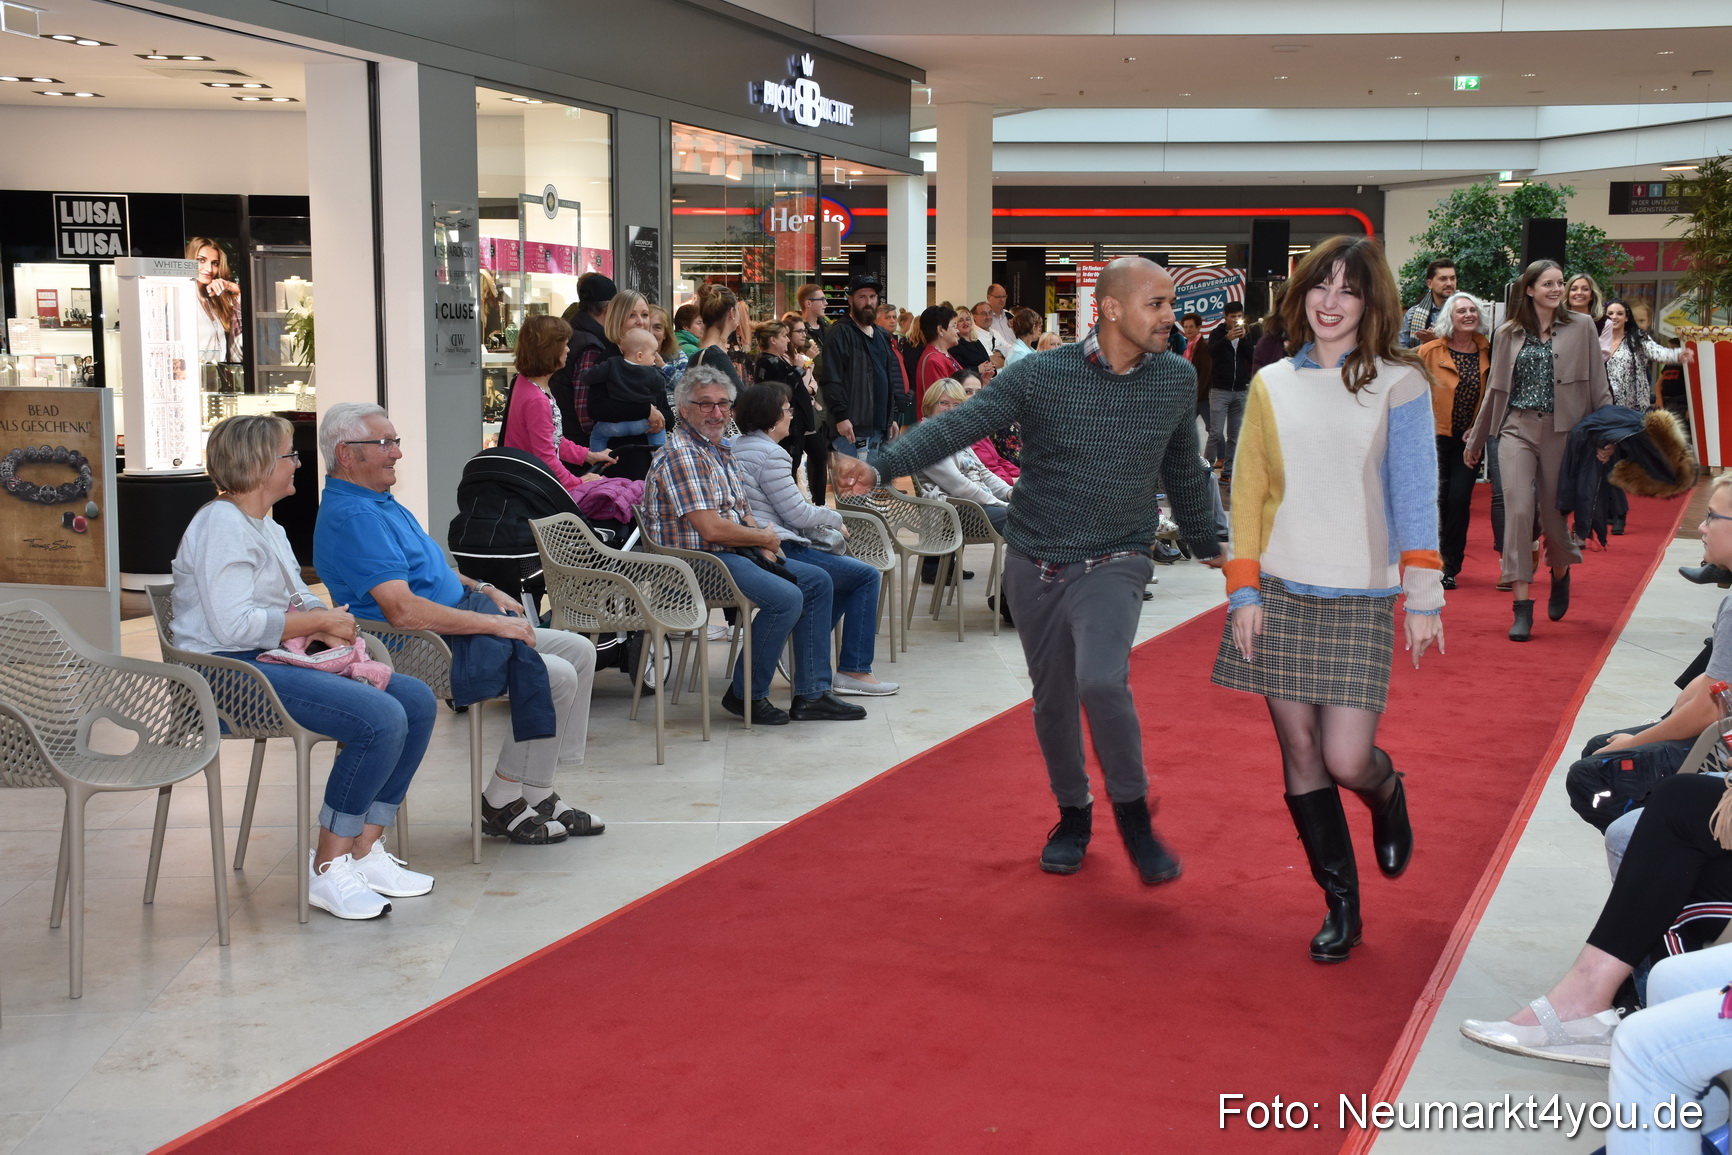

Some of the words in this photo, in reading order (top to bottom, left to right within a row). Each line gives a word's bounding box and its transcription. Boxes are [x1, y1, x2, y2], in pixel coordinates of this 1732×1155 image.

[763, 80, 796, 113] BIJOU
[60, 201, 122, 224] LUISA
[770, 206, 845, 232] Heris
[62, 232, 123, 255] LUISA
[439, 245, 473, 258] SAROVSKI
[153, 260, 183, 270] WHITE
[441, 302, 475, 320] CLUSE
[27, 404, 60, 416] BEAD
[0, 420, 19, 432] ALS
